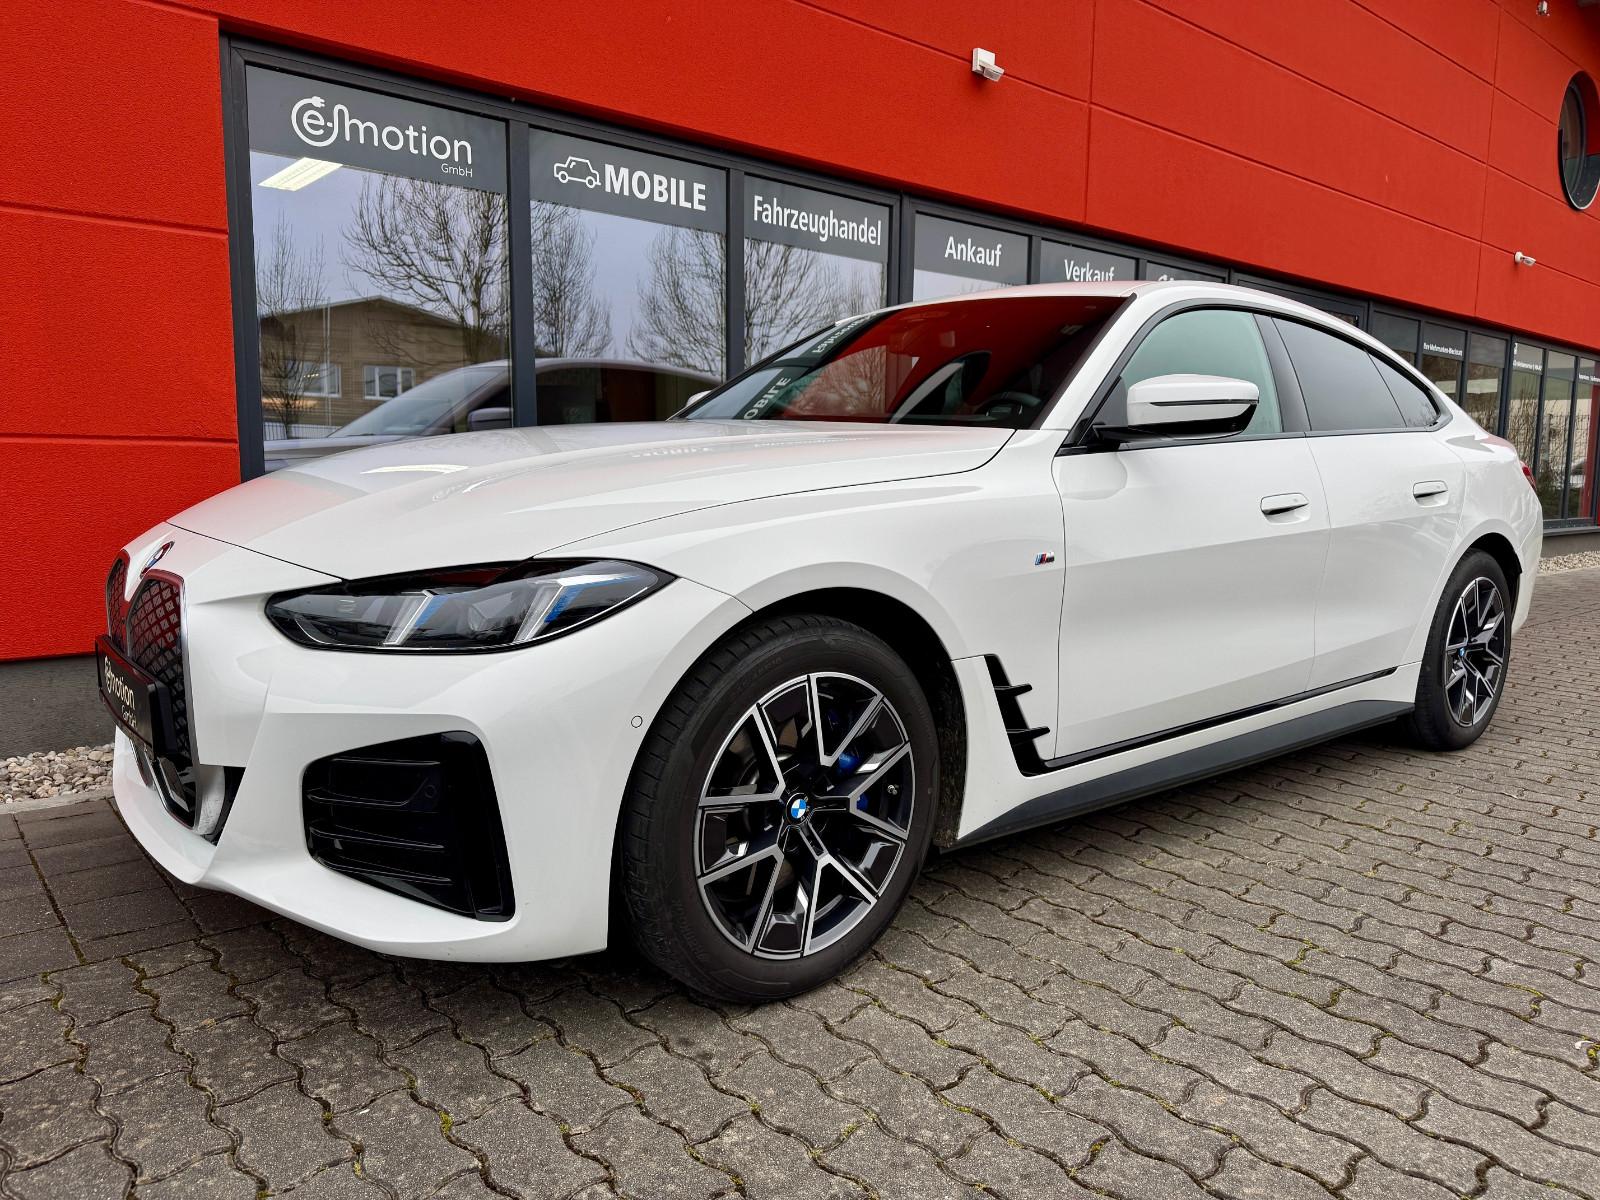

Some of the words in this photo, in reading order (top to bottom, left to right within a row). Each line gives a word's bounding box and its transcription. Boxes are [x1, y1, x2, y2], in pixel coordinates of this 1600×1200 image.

[441, 163, 473, 178] GmbH
[604, 163, 706, 211] MOBILE
[753, 194, 882, 246] Fahrzeughandel
[944, 235, 1002, 267] Ankauf
[1064, 259, 1115, 282] Verkauf
